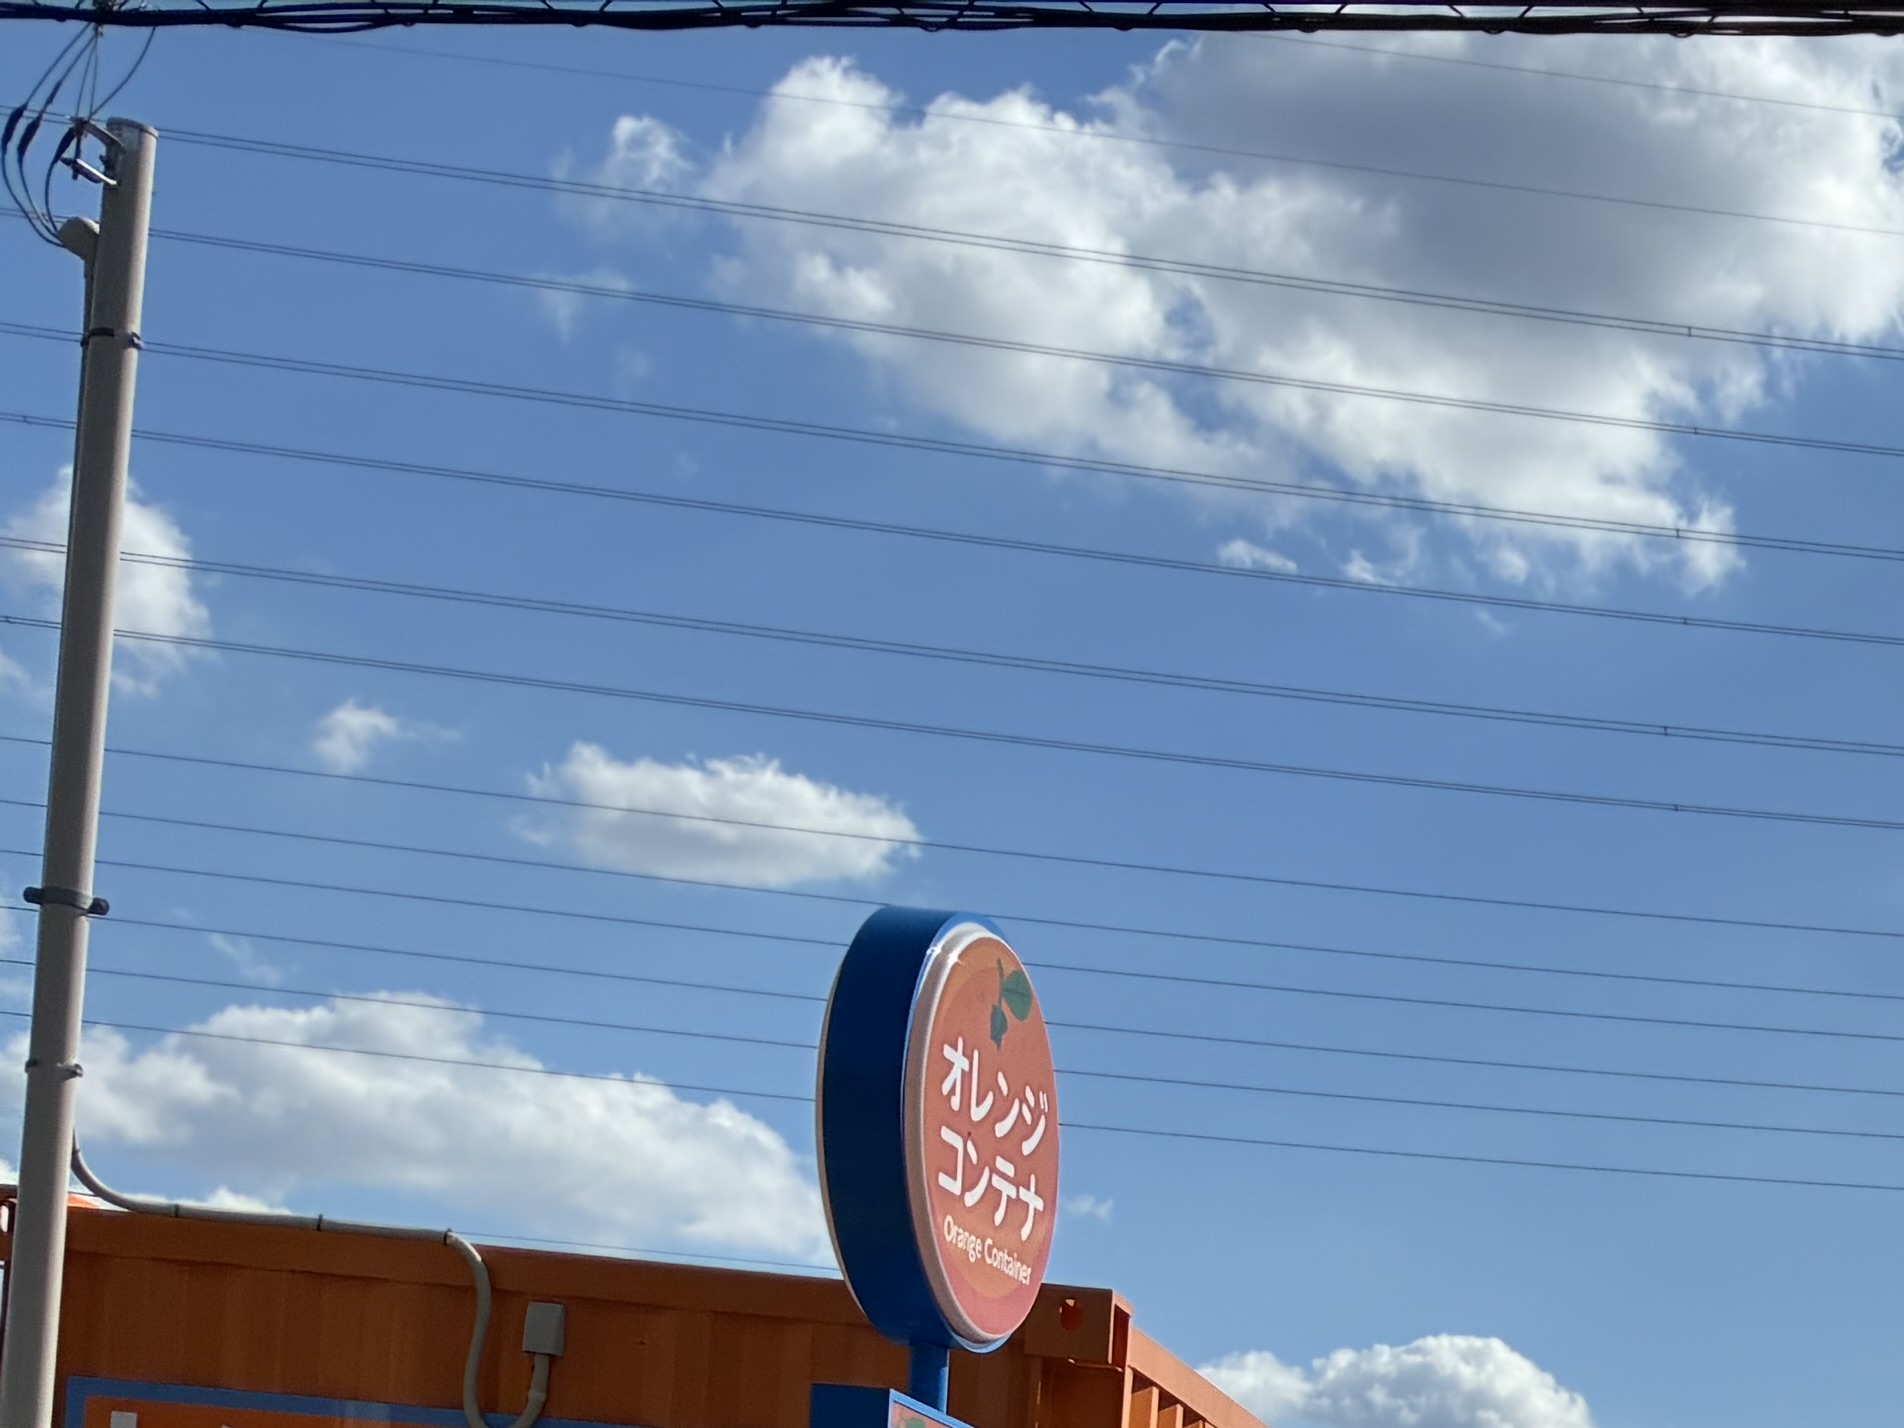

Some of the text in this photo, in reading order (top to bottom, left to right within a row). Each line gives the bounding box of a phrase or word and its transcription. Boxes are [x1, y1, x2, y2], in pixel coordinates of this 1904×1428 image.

[941, 1036, 1049, 1157] オレンジ
[938, 1125, 1045, 1242] コンテナ
[944, 1214, 1032, 1285] Orange Container
